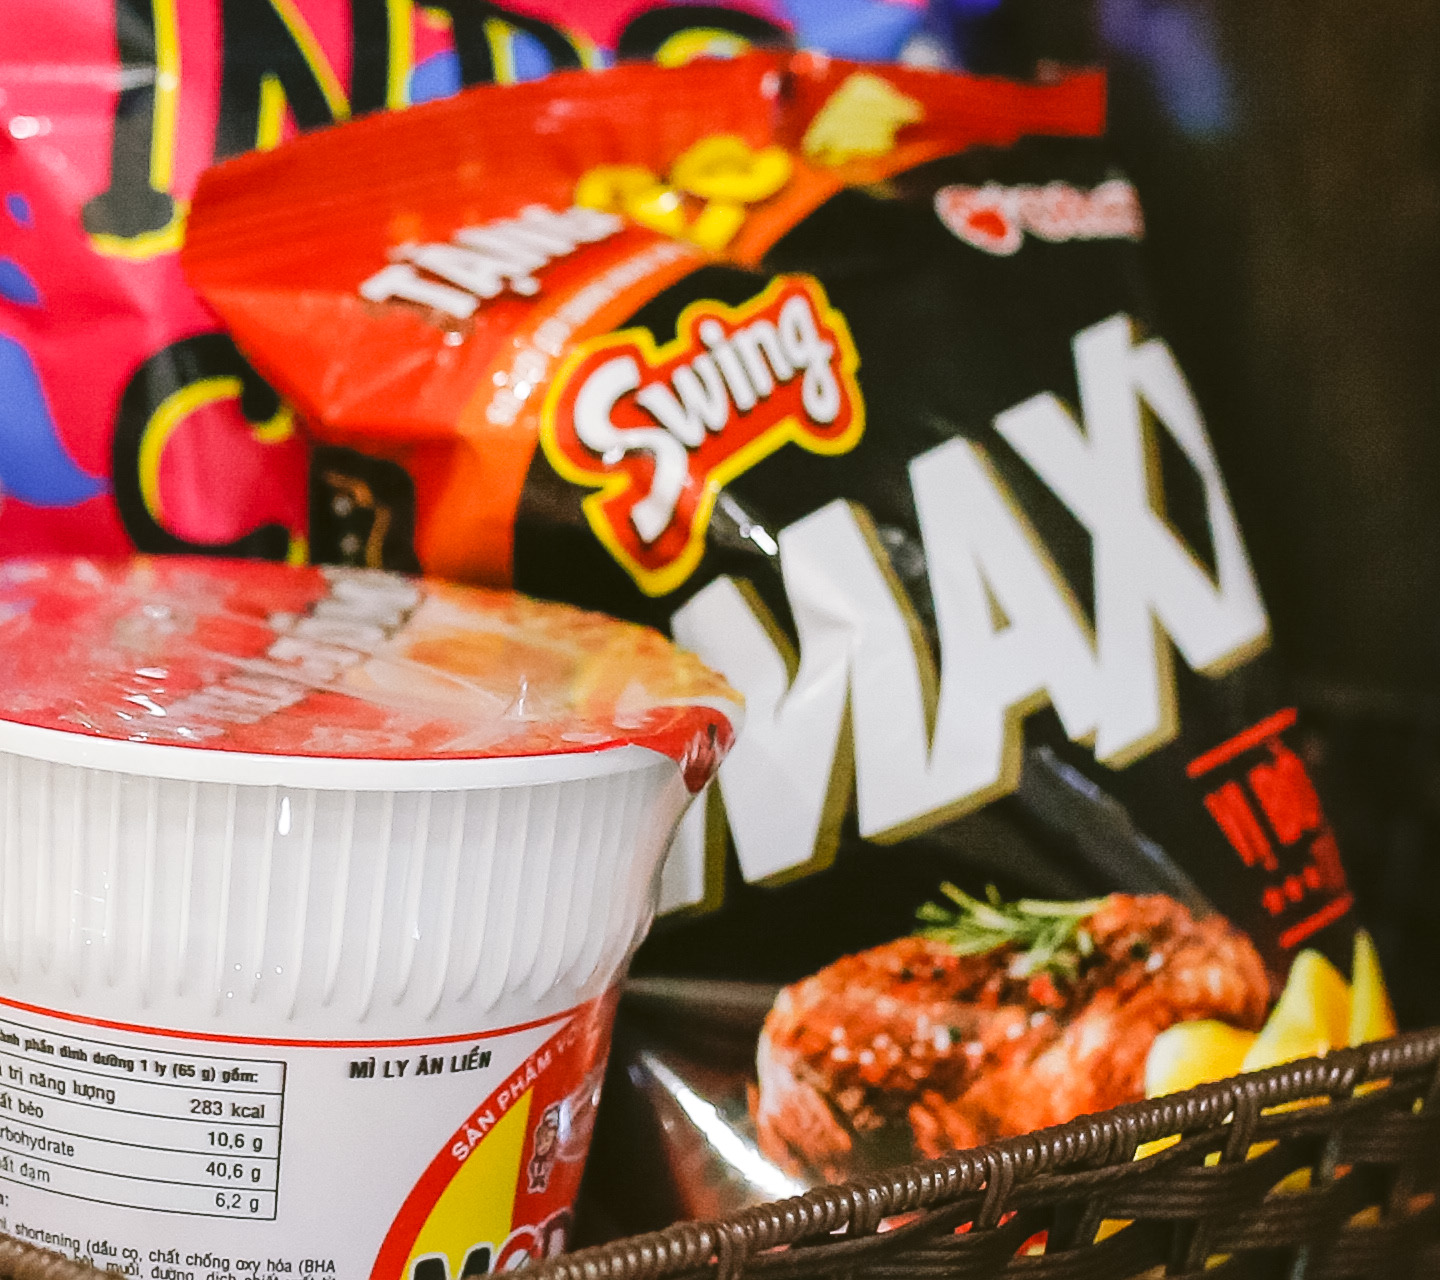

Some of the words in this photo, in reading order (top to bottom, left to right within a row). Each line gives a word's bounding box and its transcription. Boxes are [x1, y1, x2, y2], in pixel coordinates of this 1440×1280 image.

[575, 295, 840, 543] Swing
[155, 1061, 167, 1077] ly
[173, 1063, 196, 1079] (65
[349, 1057, 375, 1078] MÌ
[382, 1060, 409, 1078] LY
[29, 1071, 66, 1095] năng
[190, 1100, 223, 1116] 283
[232, 1101, 265, 1119] kcal
[208, 1131, 244, 1150] 10,6
[20, 1163, 50, 1184] đạm
[215, 1193, 241, 1211] 6,2
[205, 1162, 243, 1181] 40,6
[15, 1222, 80, 1253] shortening
[236, 1260, 260, 1274] oxy
[298, 1259, 335, 1273] (BHA
